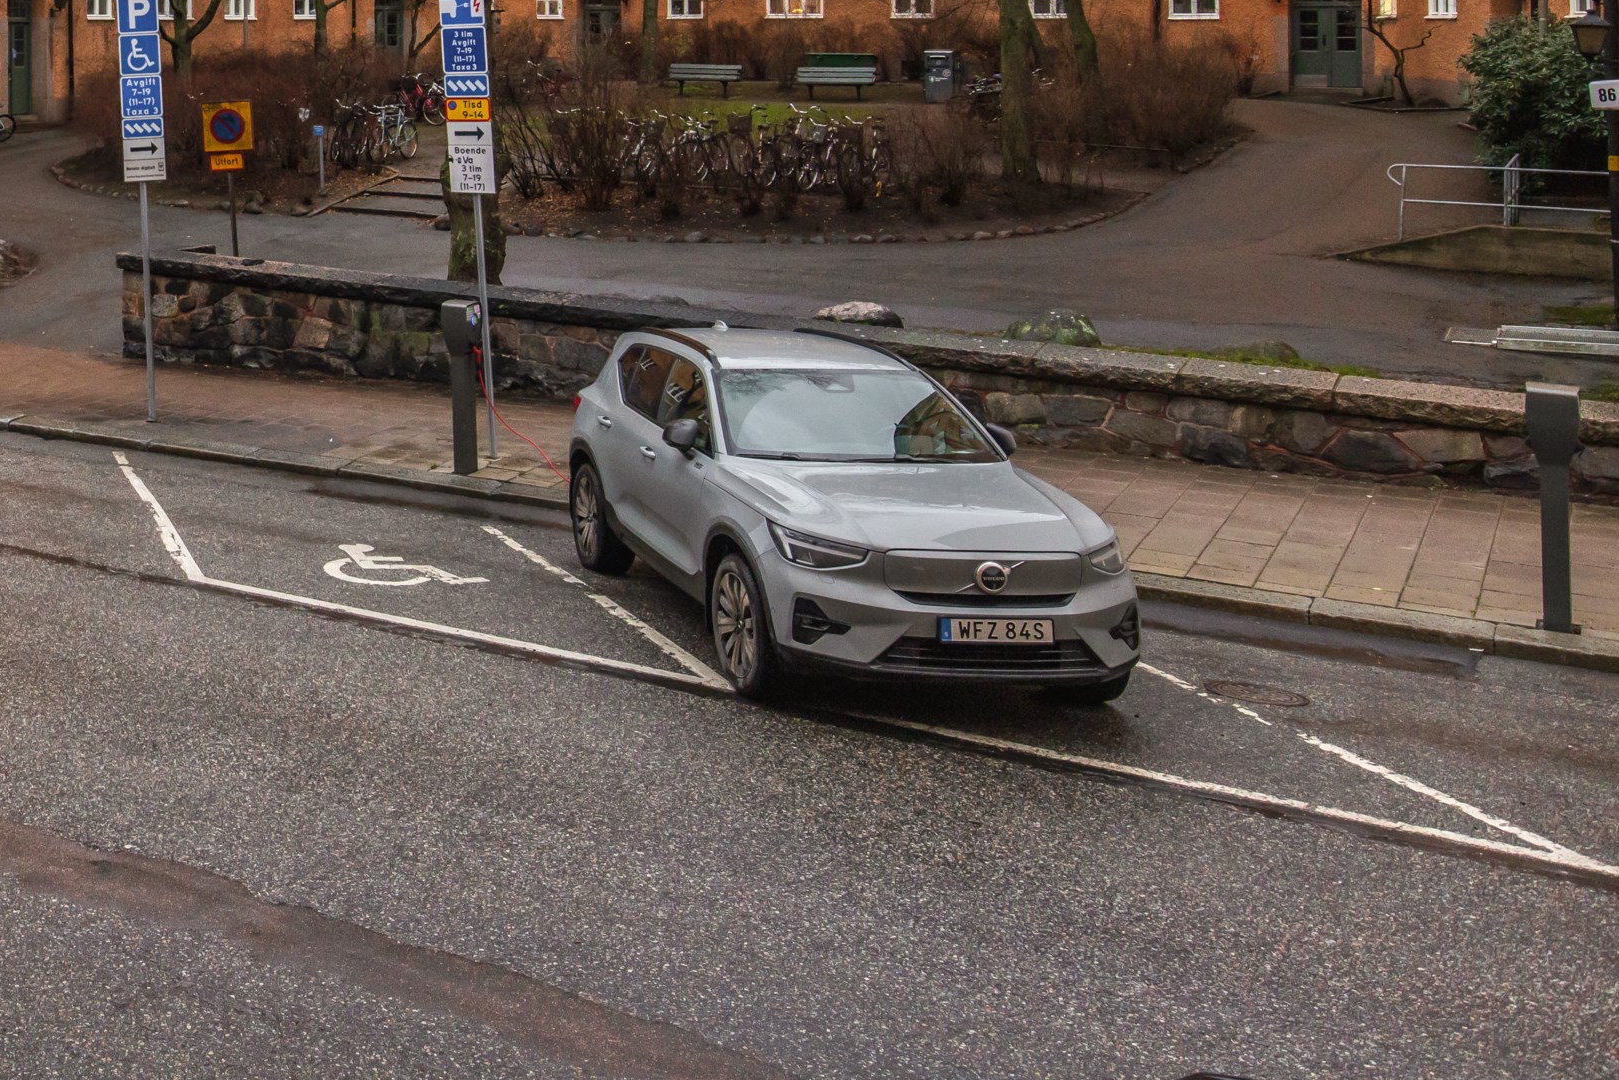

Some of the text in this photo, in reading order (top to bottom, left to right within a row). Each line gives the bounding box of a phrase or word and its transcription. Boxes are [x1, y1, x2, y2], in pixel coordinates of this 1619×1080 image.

[461, 30, 473, 38] tim
[452, 39, 476, 47] Avgift
[126, 78, 156, 88] Avgift
[131, 88, 151, 96] 7-19
[1598, 88, 1617, 102] 86
[463, 101, 482, 109] Tisd
[126, 108, 149, 116] Taxa
[462, 111, 483, 119] 9-14
[454, 147, 486, 155] Boende
[215, 158, 238, 166] Utfart
[462, 174, 481, 182] 7-19
[958, 621, 1044, 640] WFZ 84S
